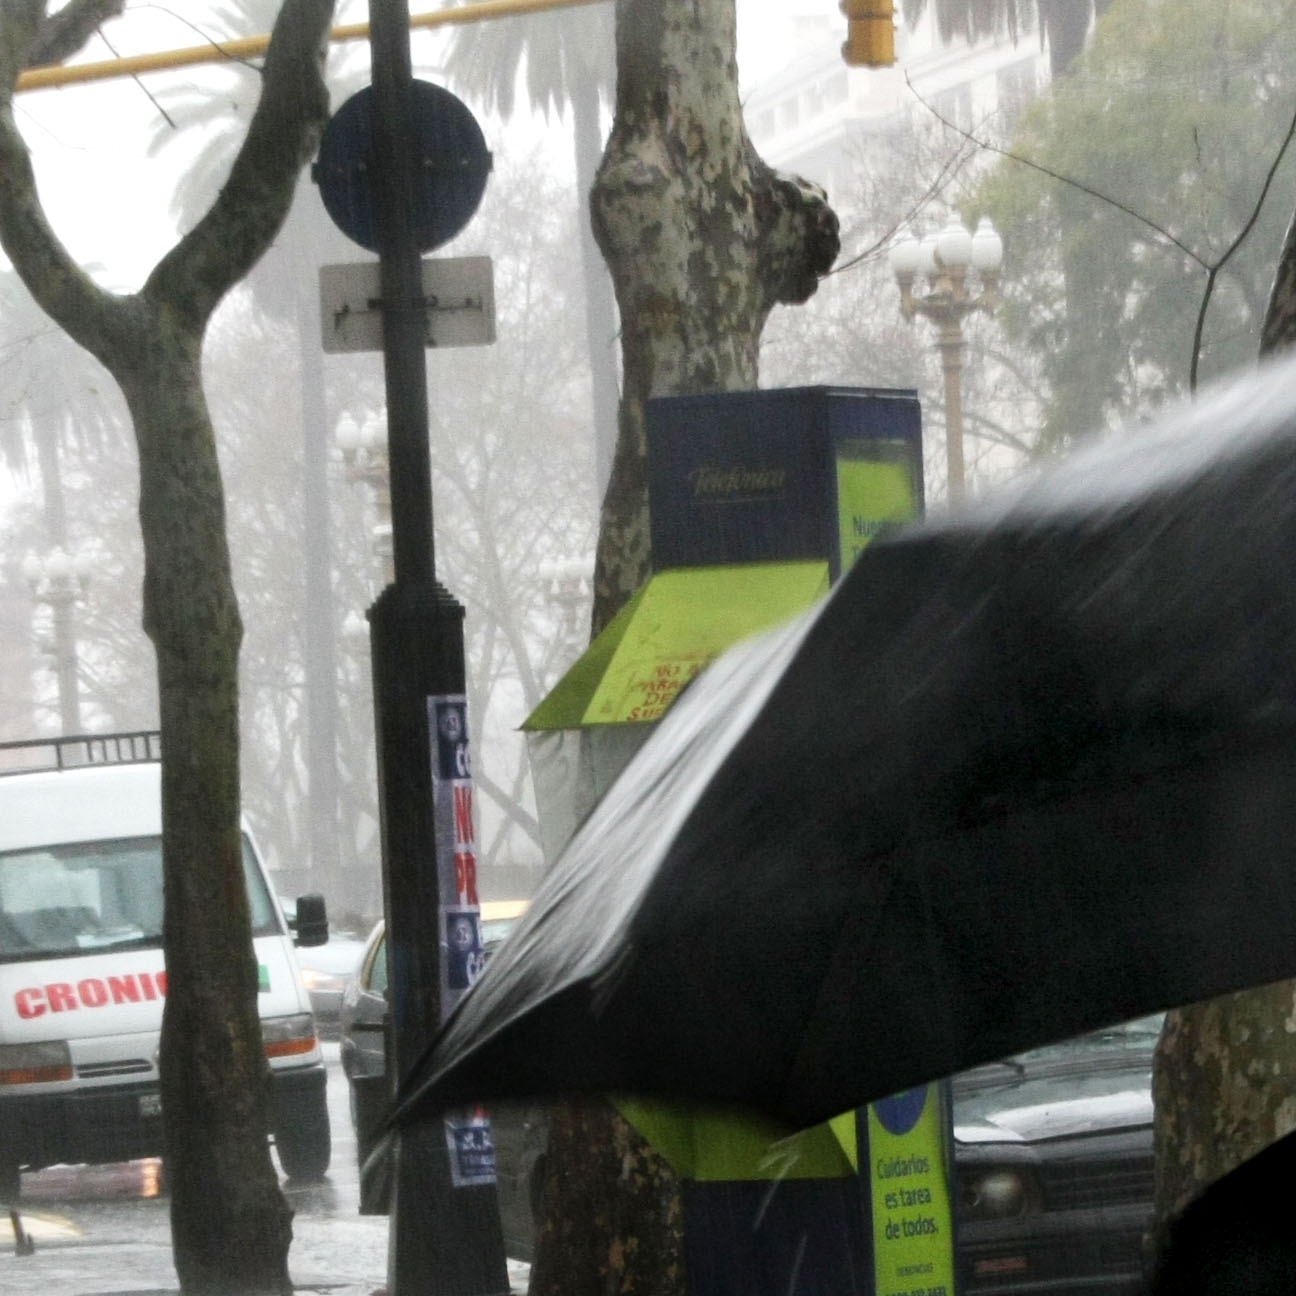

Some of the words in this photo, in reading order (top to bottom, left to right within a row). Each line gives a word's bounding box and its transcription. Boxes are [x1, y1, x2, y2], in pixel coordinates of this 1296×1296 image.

[885, 1193, 897, 1209] es
[900, 1187, 931, 1207] tarea
[885, 1218, 900, 1240] de
